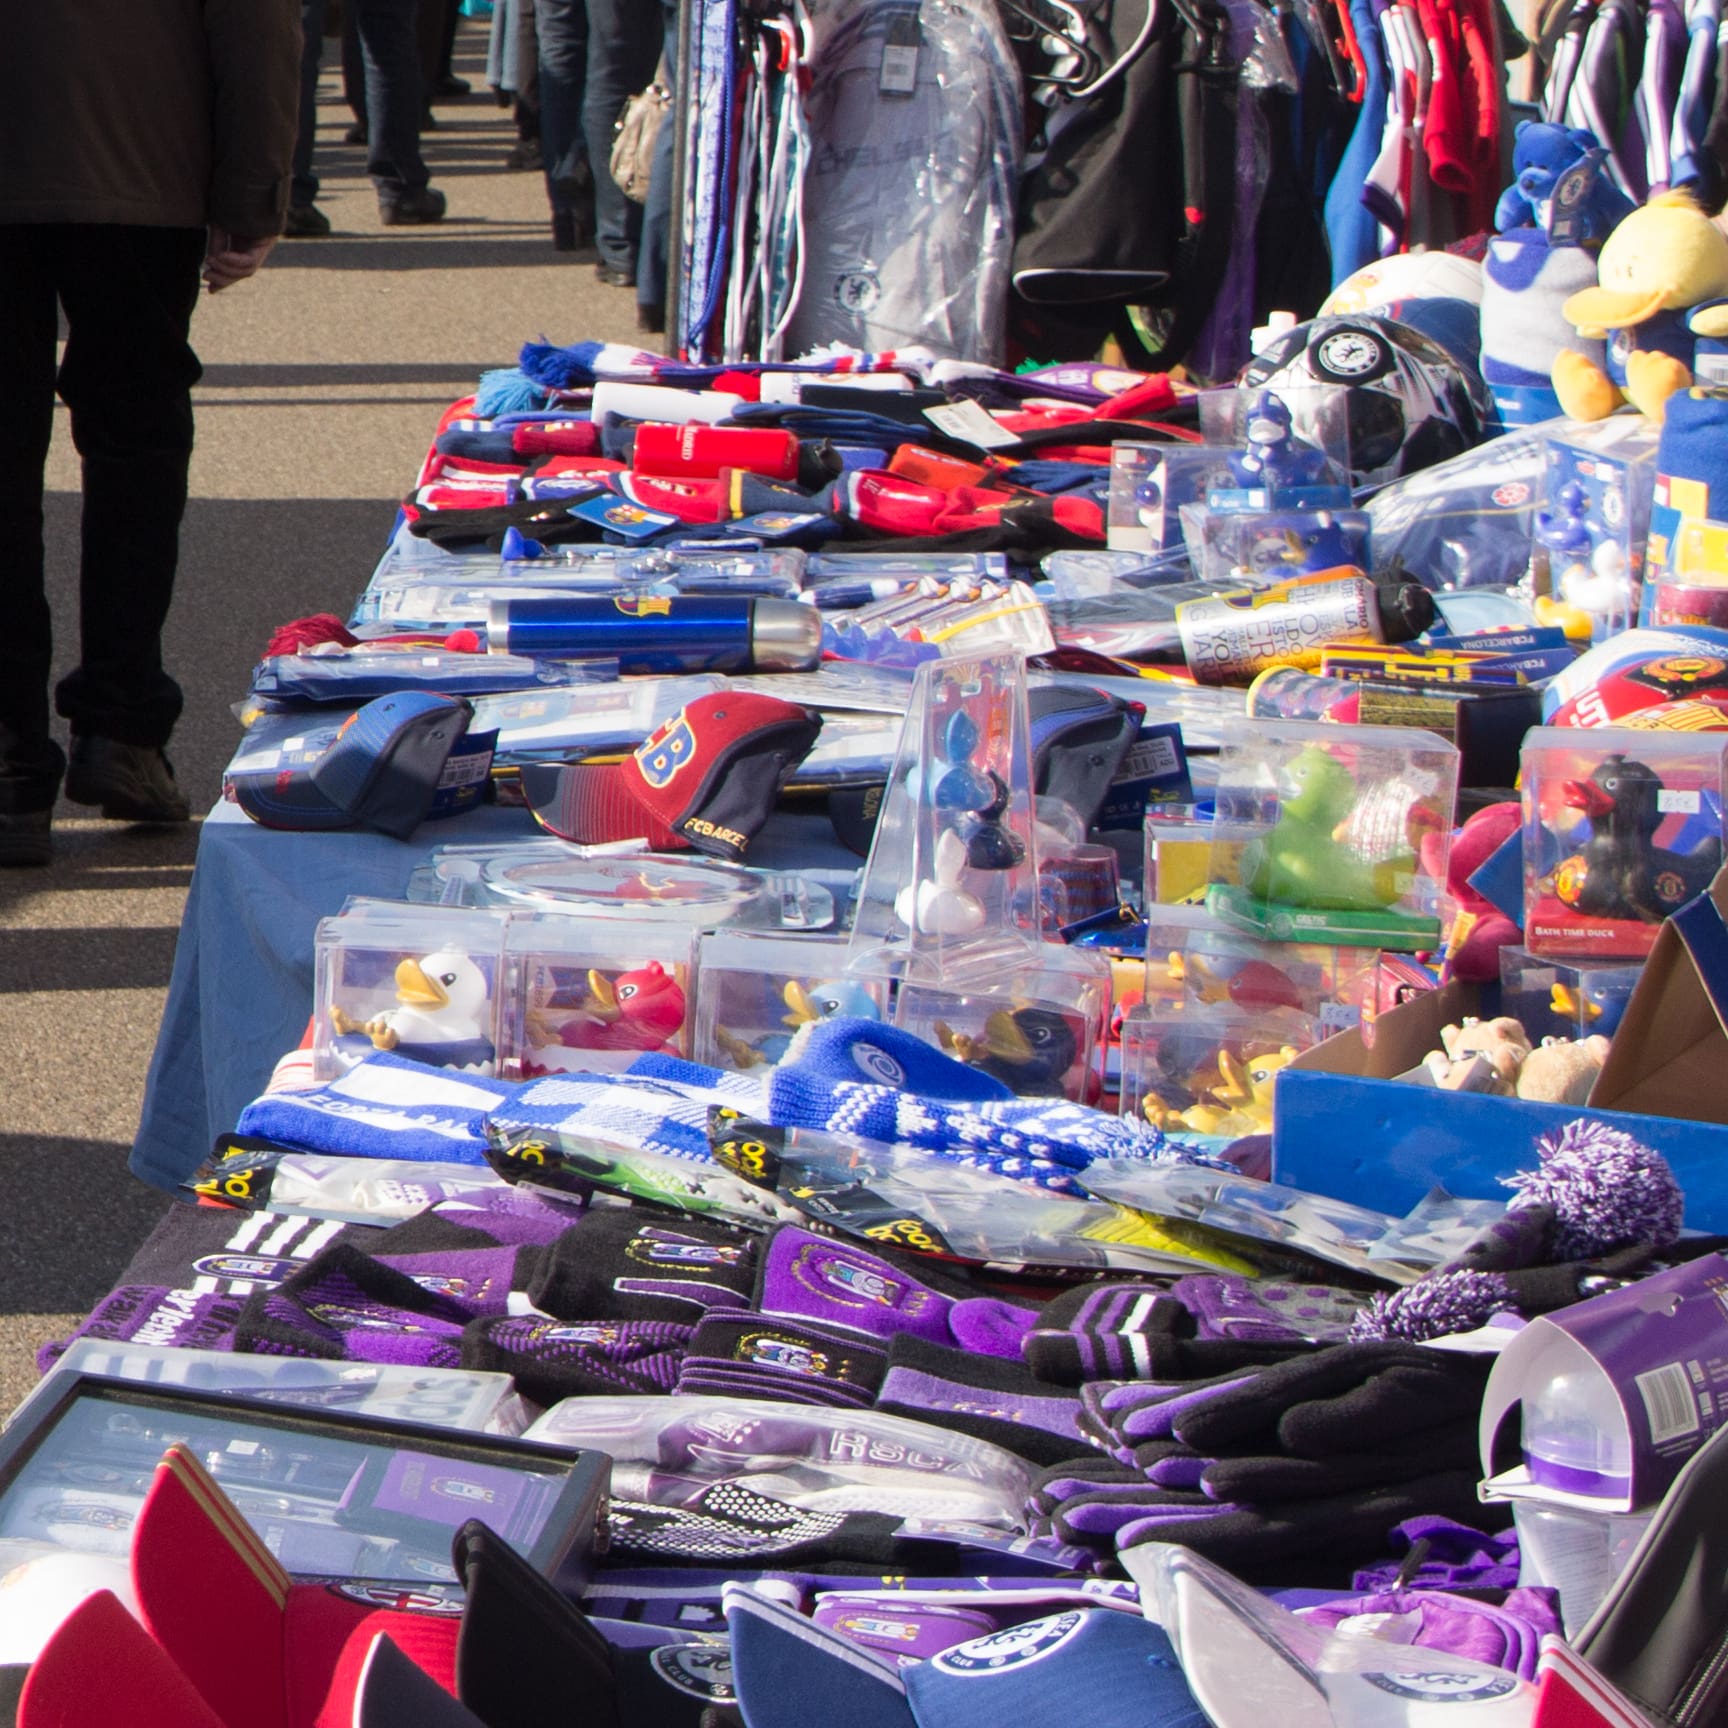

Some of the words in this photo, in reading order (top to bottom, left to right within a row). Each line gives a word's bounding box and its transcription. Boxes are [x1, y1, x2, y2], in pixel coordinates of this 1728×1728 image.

[1535, 926, 1560, 937] BATH
[1563, 927, 1585, 938] TIME
[1587, 928, 1615, 938] DUCK
